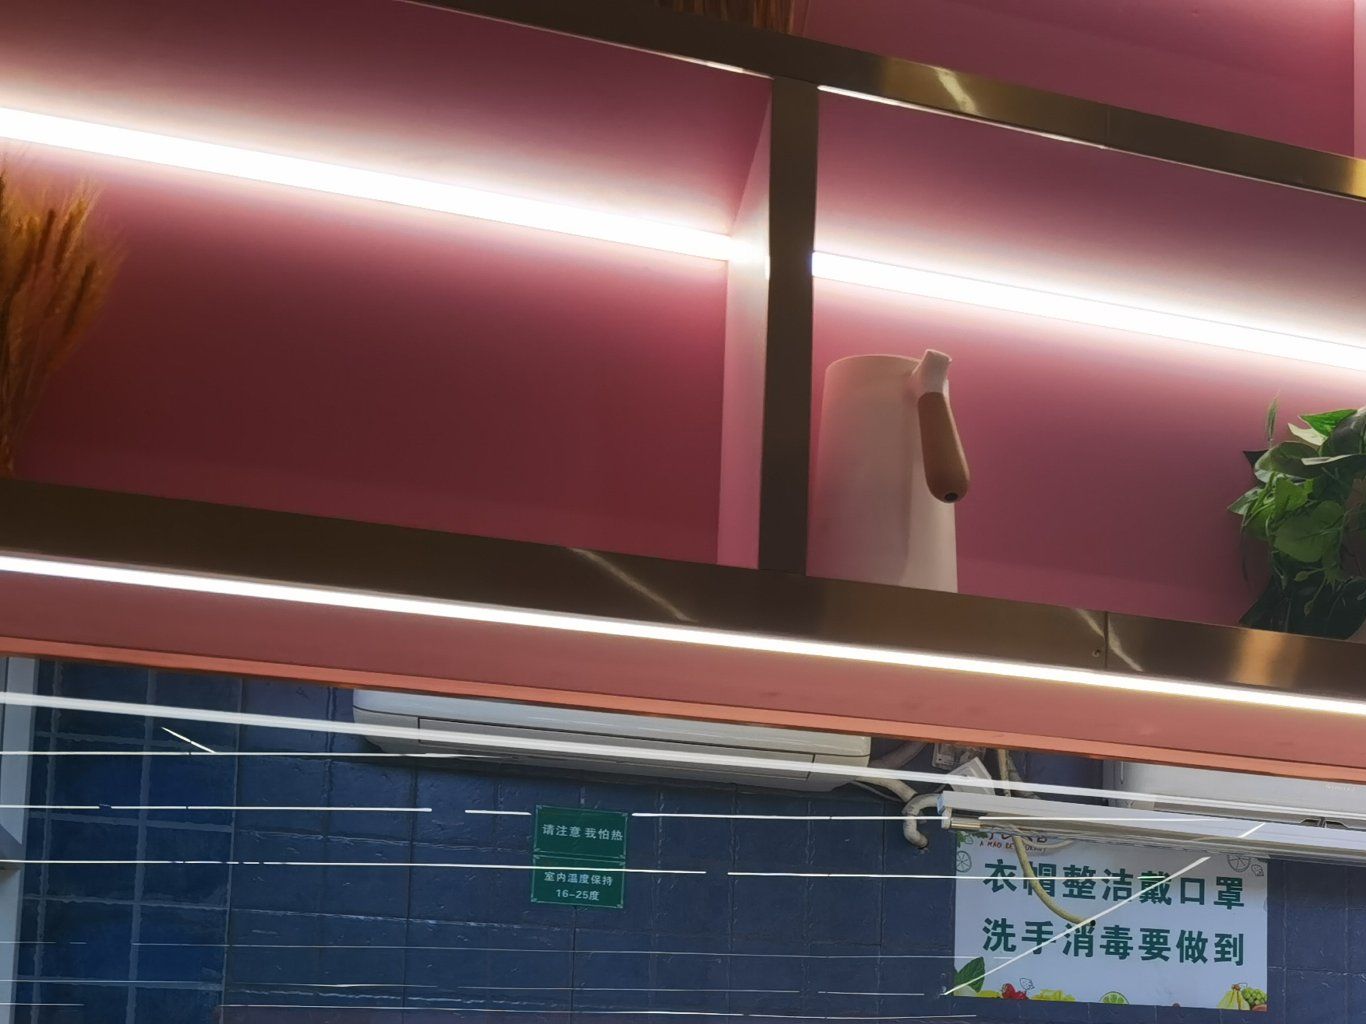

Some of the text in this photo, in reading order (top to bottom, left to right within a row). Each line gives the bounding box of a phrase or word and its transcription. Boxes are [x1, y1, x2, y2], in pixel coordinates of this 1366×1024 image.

[542, 824, 623, 841] 请注意 我怕热
[544, 871, 613, 886] 室内温度保持
[983, 858, 1245, 910] 衣帽整洁戴口罩
[556, 889, 600, 901] 16-25度
[982, 917, 1245, 967] 洗手消毒要做到
